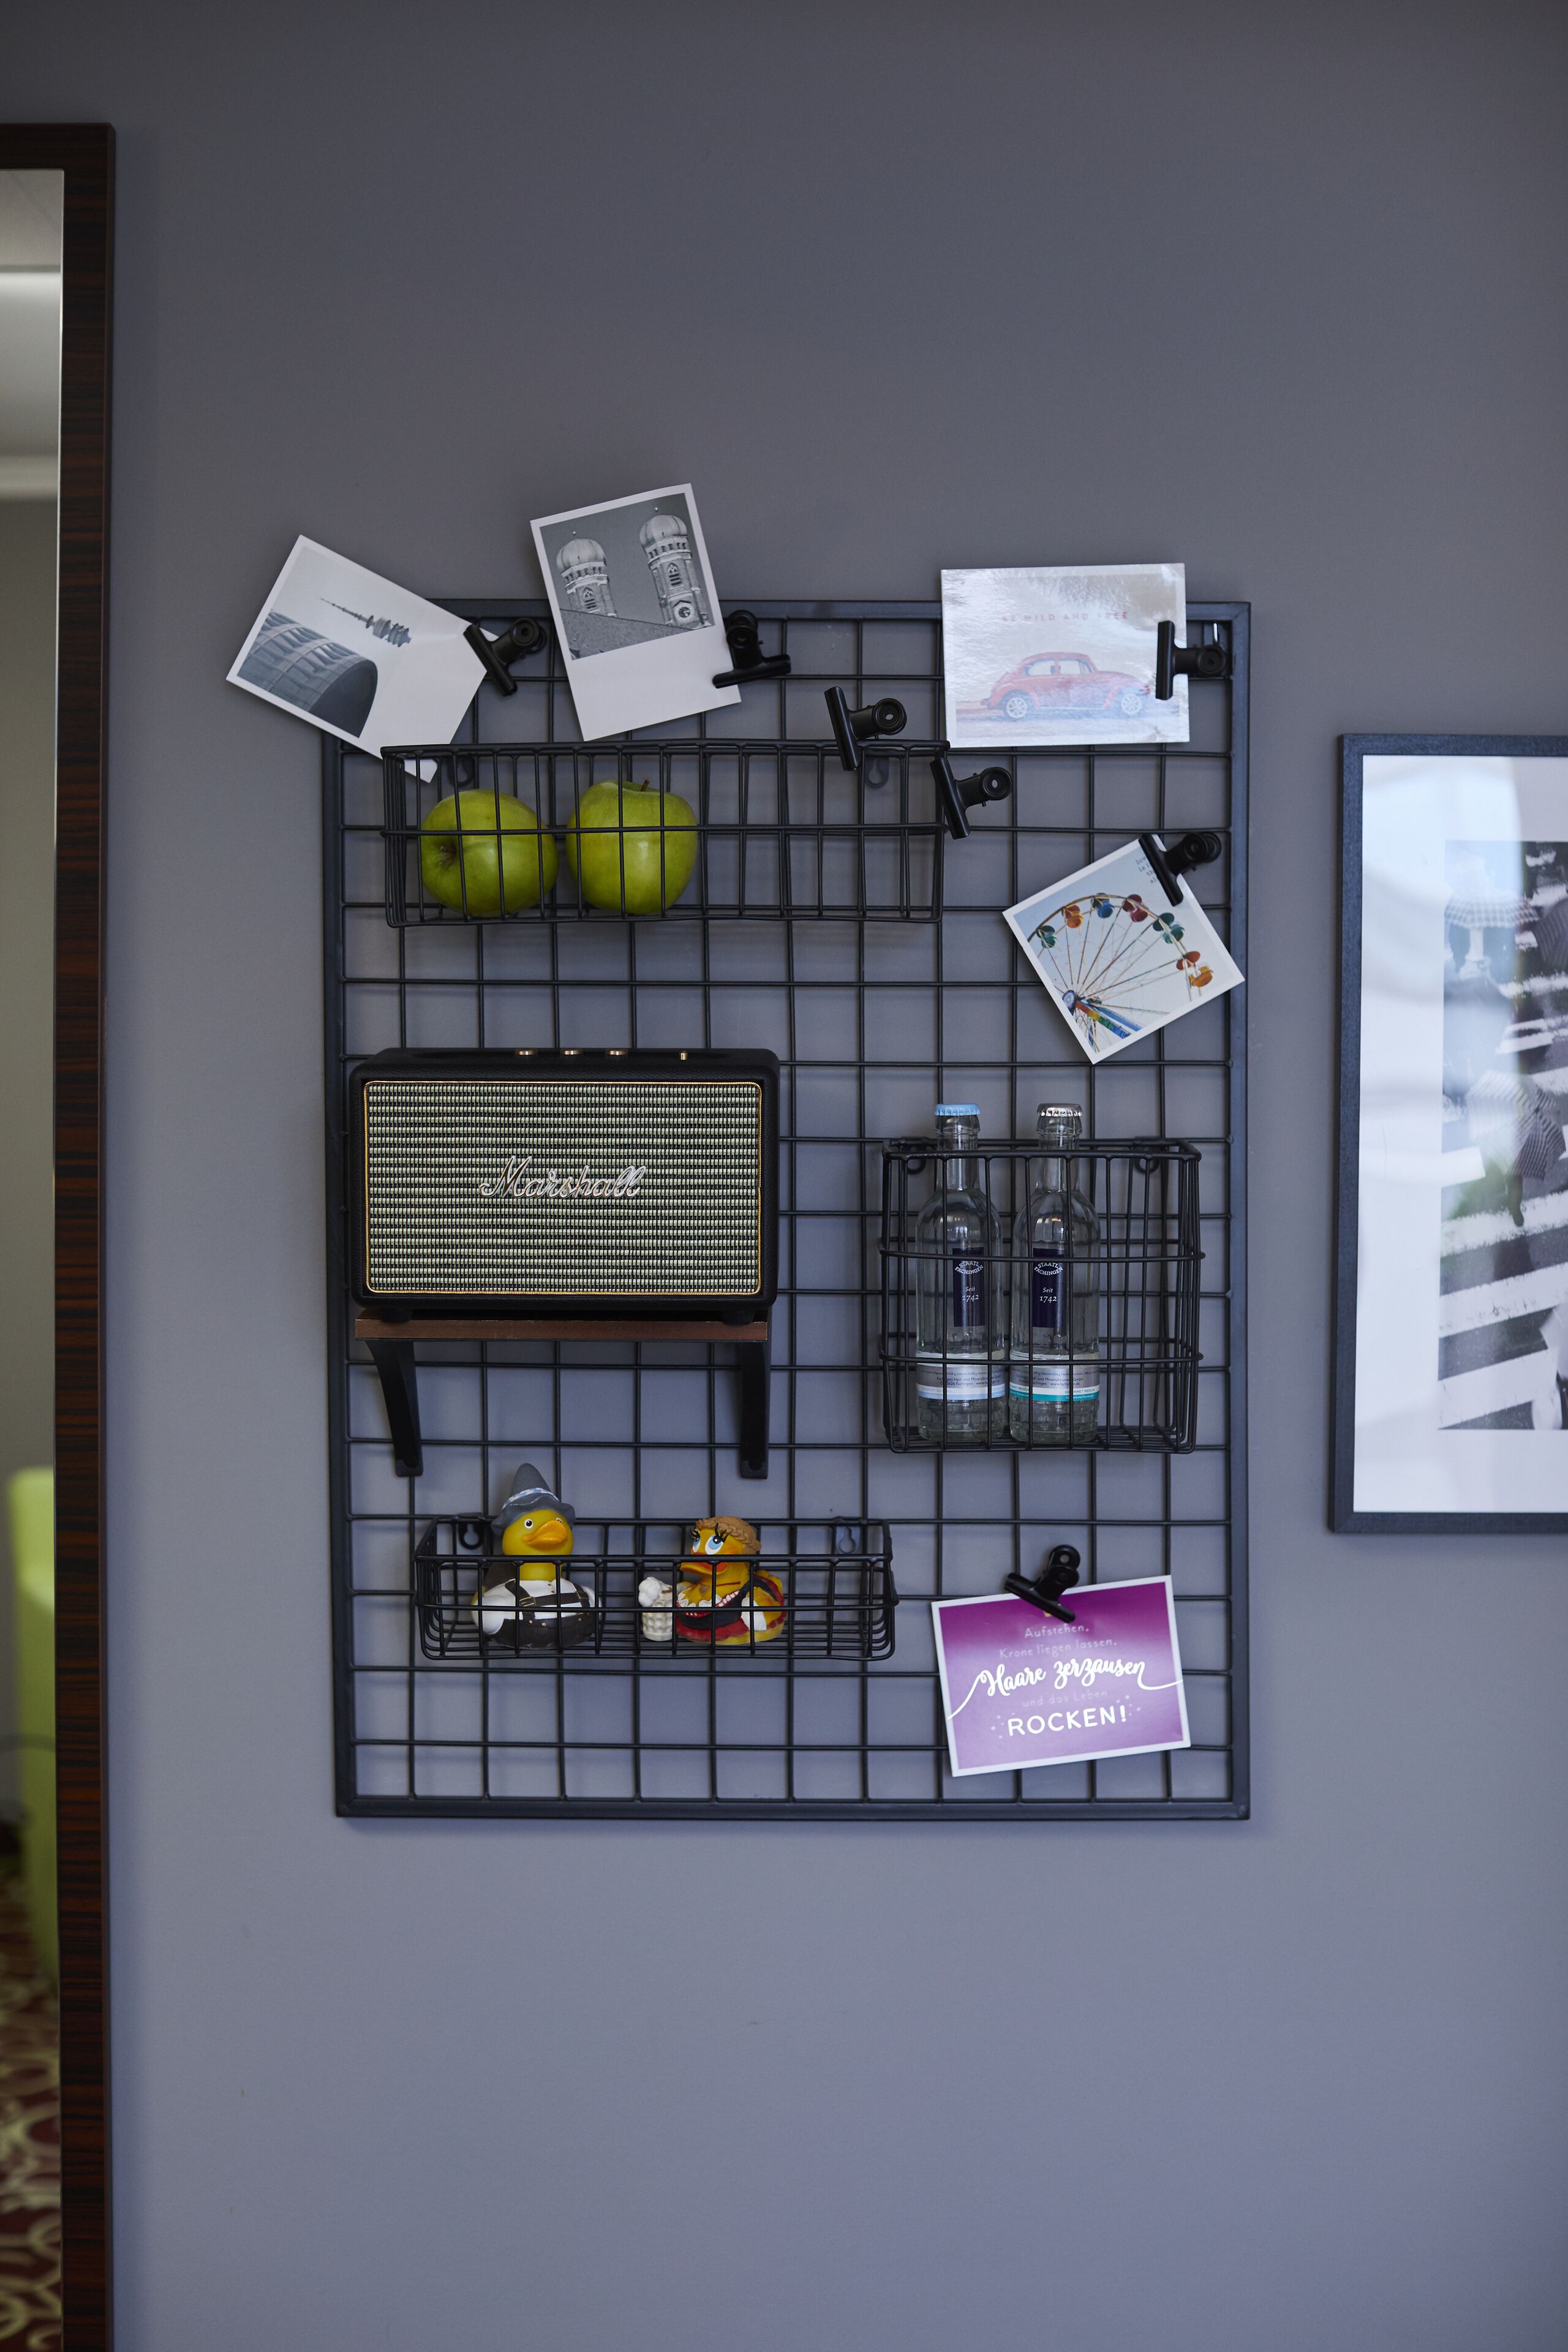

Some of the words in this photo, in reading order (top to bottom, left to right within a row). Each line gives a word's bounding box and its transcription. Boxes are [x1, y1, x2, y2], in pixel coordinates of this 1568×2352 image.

[1024, 613, 1055, 622] WILD
[1063, 612, 1089, 621] AND
[1098, 611, 1128, 620] FREE
[479, 1155, 647, 1199] Marshall
[955, 1265, 983, 1275] FACHINGEN
[1034, 1266, 1063, 1275] FACHINGEN
[1024, 1623, 1090, 1639] Aufstehen.
[1000, 1647, 1034, 1659] Krone
[1036, 1643, 1072, 1658] liegen
[1076, 1638, 1117, 1650] lassen.
[970, 1662, 1047, 1700] Haare
[1053, 1657, 1158, 1691] zerzausen
[1022, 1695, 1044, 1708] und
[1049, 1693, 1069, 1705] das
[1074, 1689, 1108, 1702] Leben
[1008, 1705, 1127, 1736] ROCKEN!
